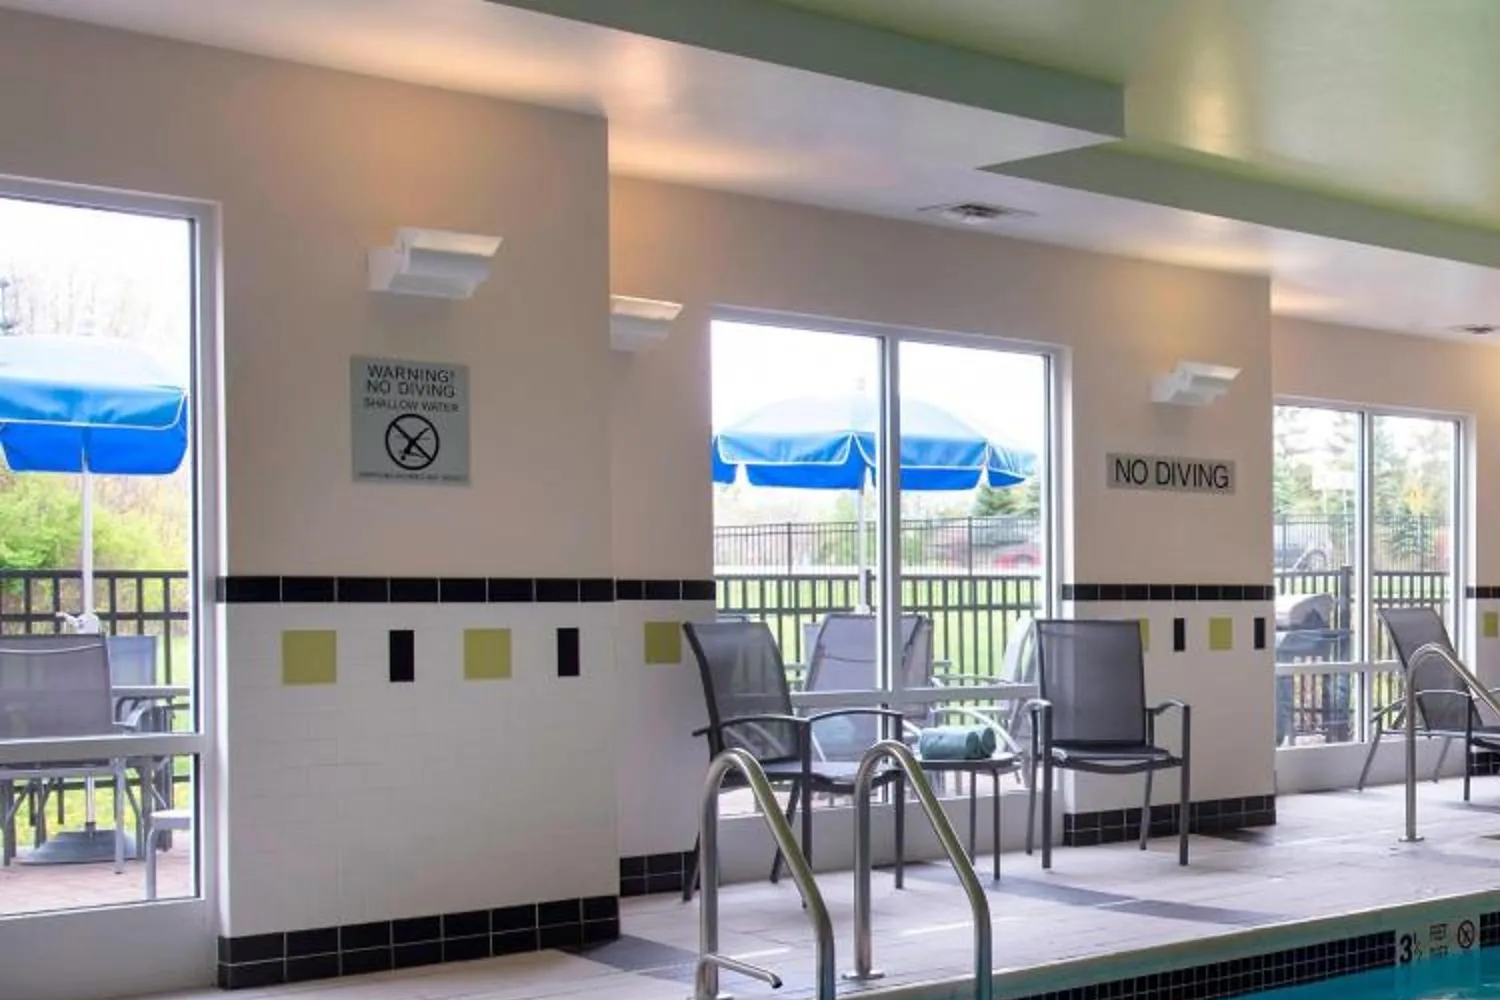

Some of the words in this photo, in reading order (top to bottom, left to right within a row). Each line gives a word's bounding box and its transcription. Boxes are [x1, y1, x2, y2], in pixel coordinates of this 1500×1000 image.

[367, 379, 391, 395] NO
[398, 381, 456, 398] DIVING
[364, 397, 419, 411] SHALLOW
[422, 400, 460, 413] WATER
[1115, 458, 1149, 485] NO
[1156, 461, 1229, 489] DIVING
